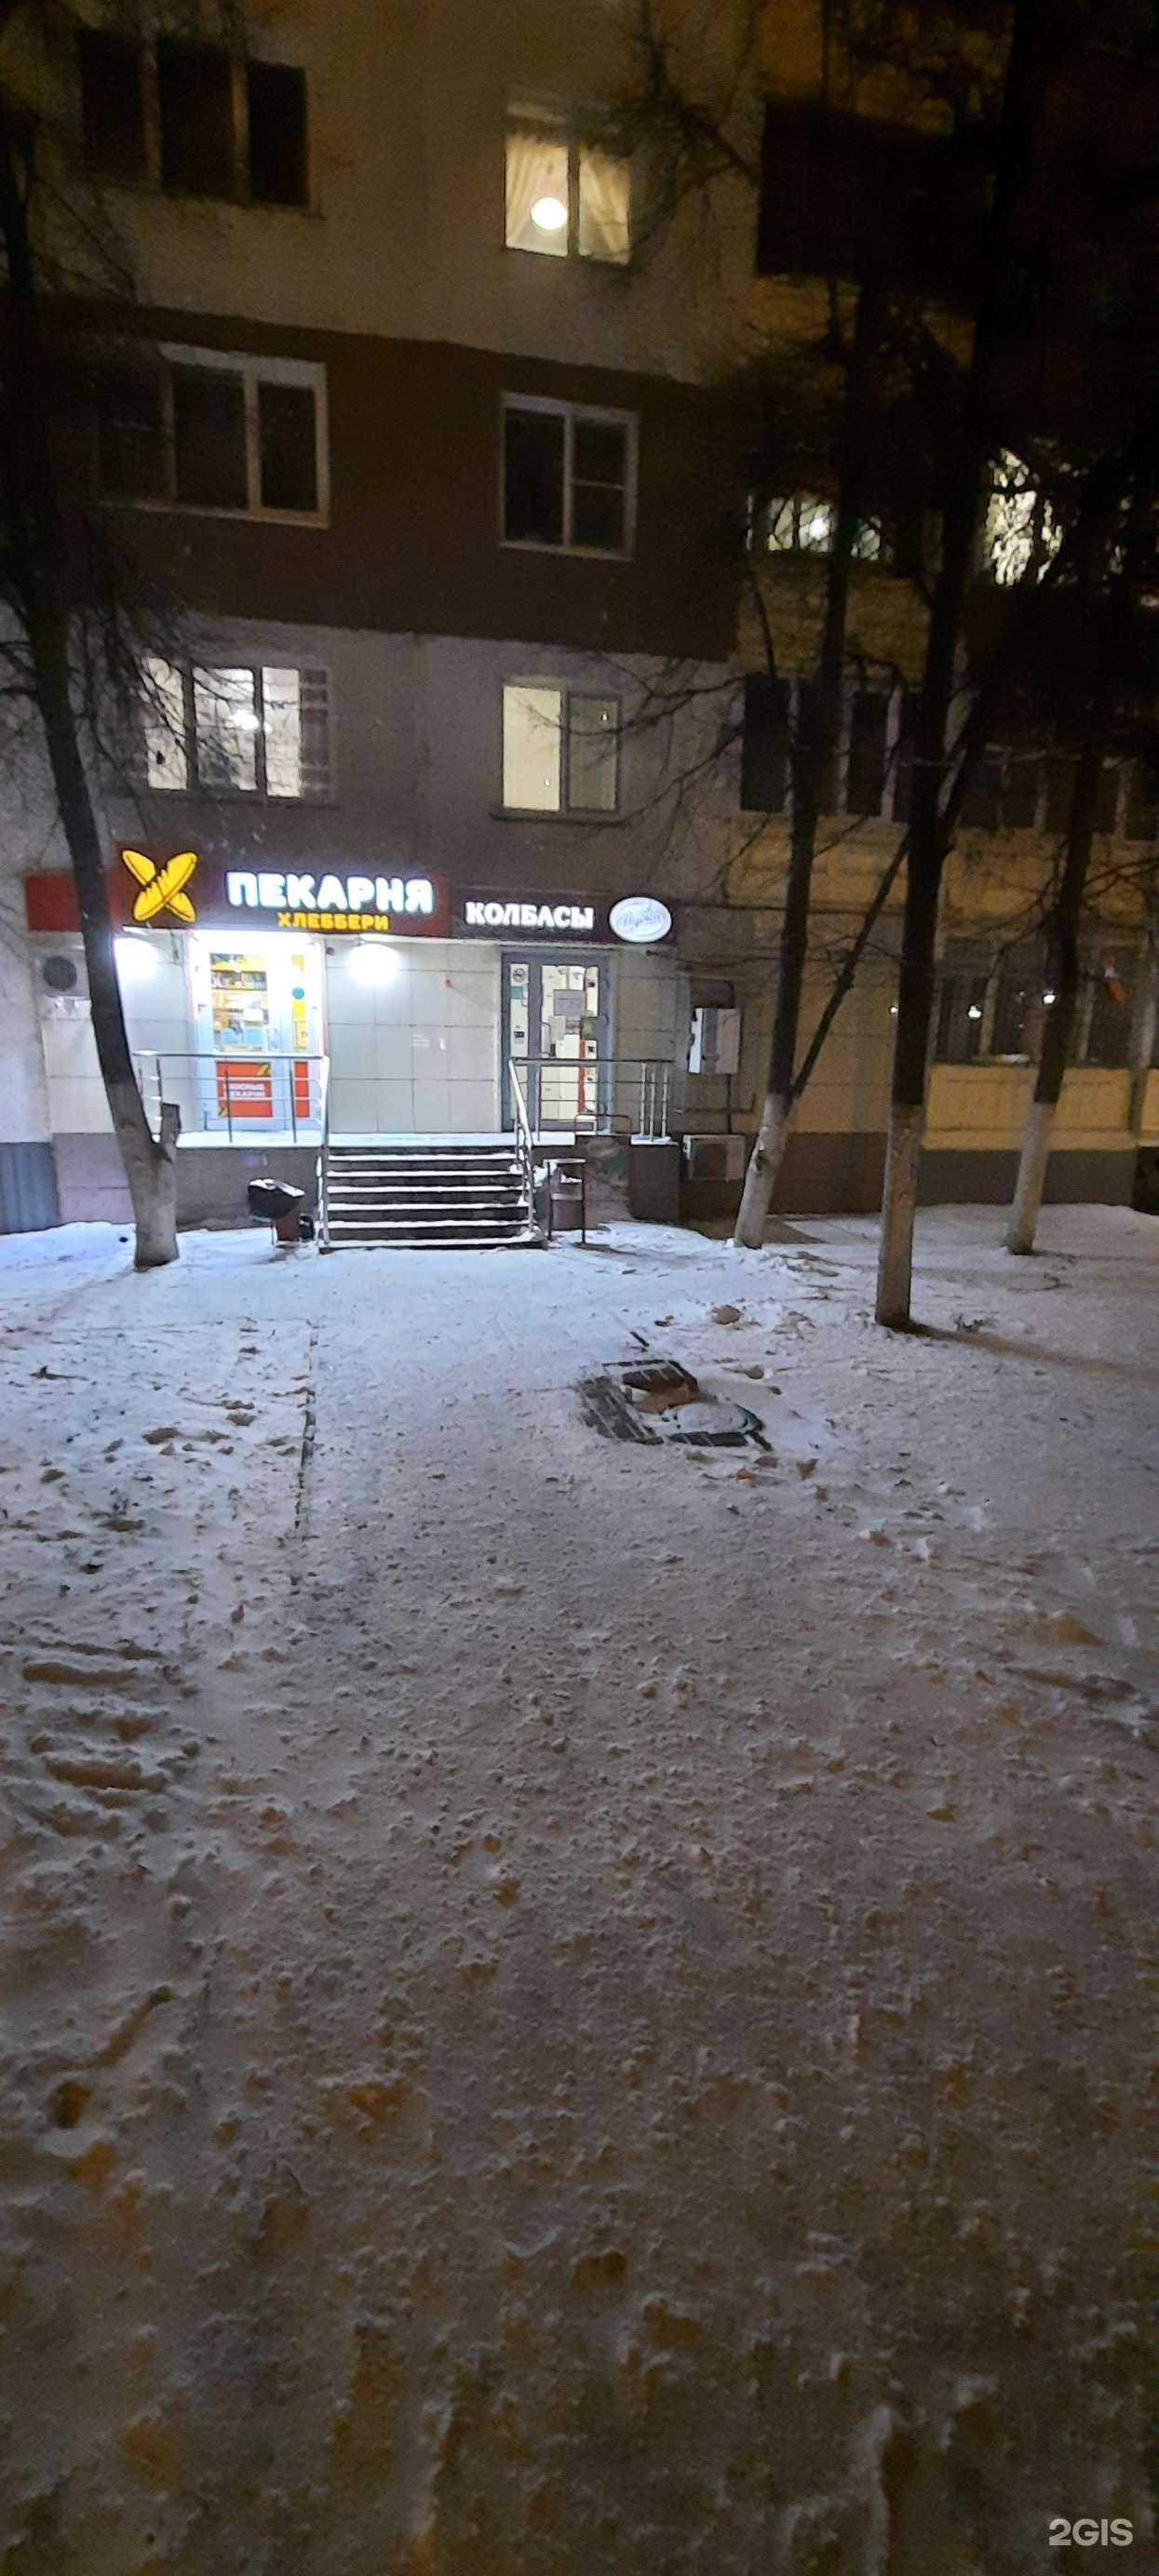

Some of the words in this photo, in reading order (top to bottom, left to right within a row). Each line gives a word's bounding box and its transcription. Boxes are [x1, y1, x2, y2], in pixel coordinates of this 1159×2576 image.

[226, 871, 434, 914] ПЕКАРНЯ
[277, 911, 389, 931] ХЛЕББЕРИ
[465, 901, 594, 930] КОЛБАСЫ
